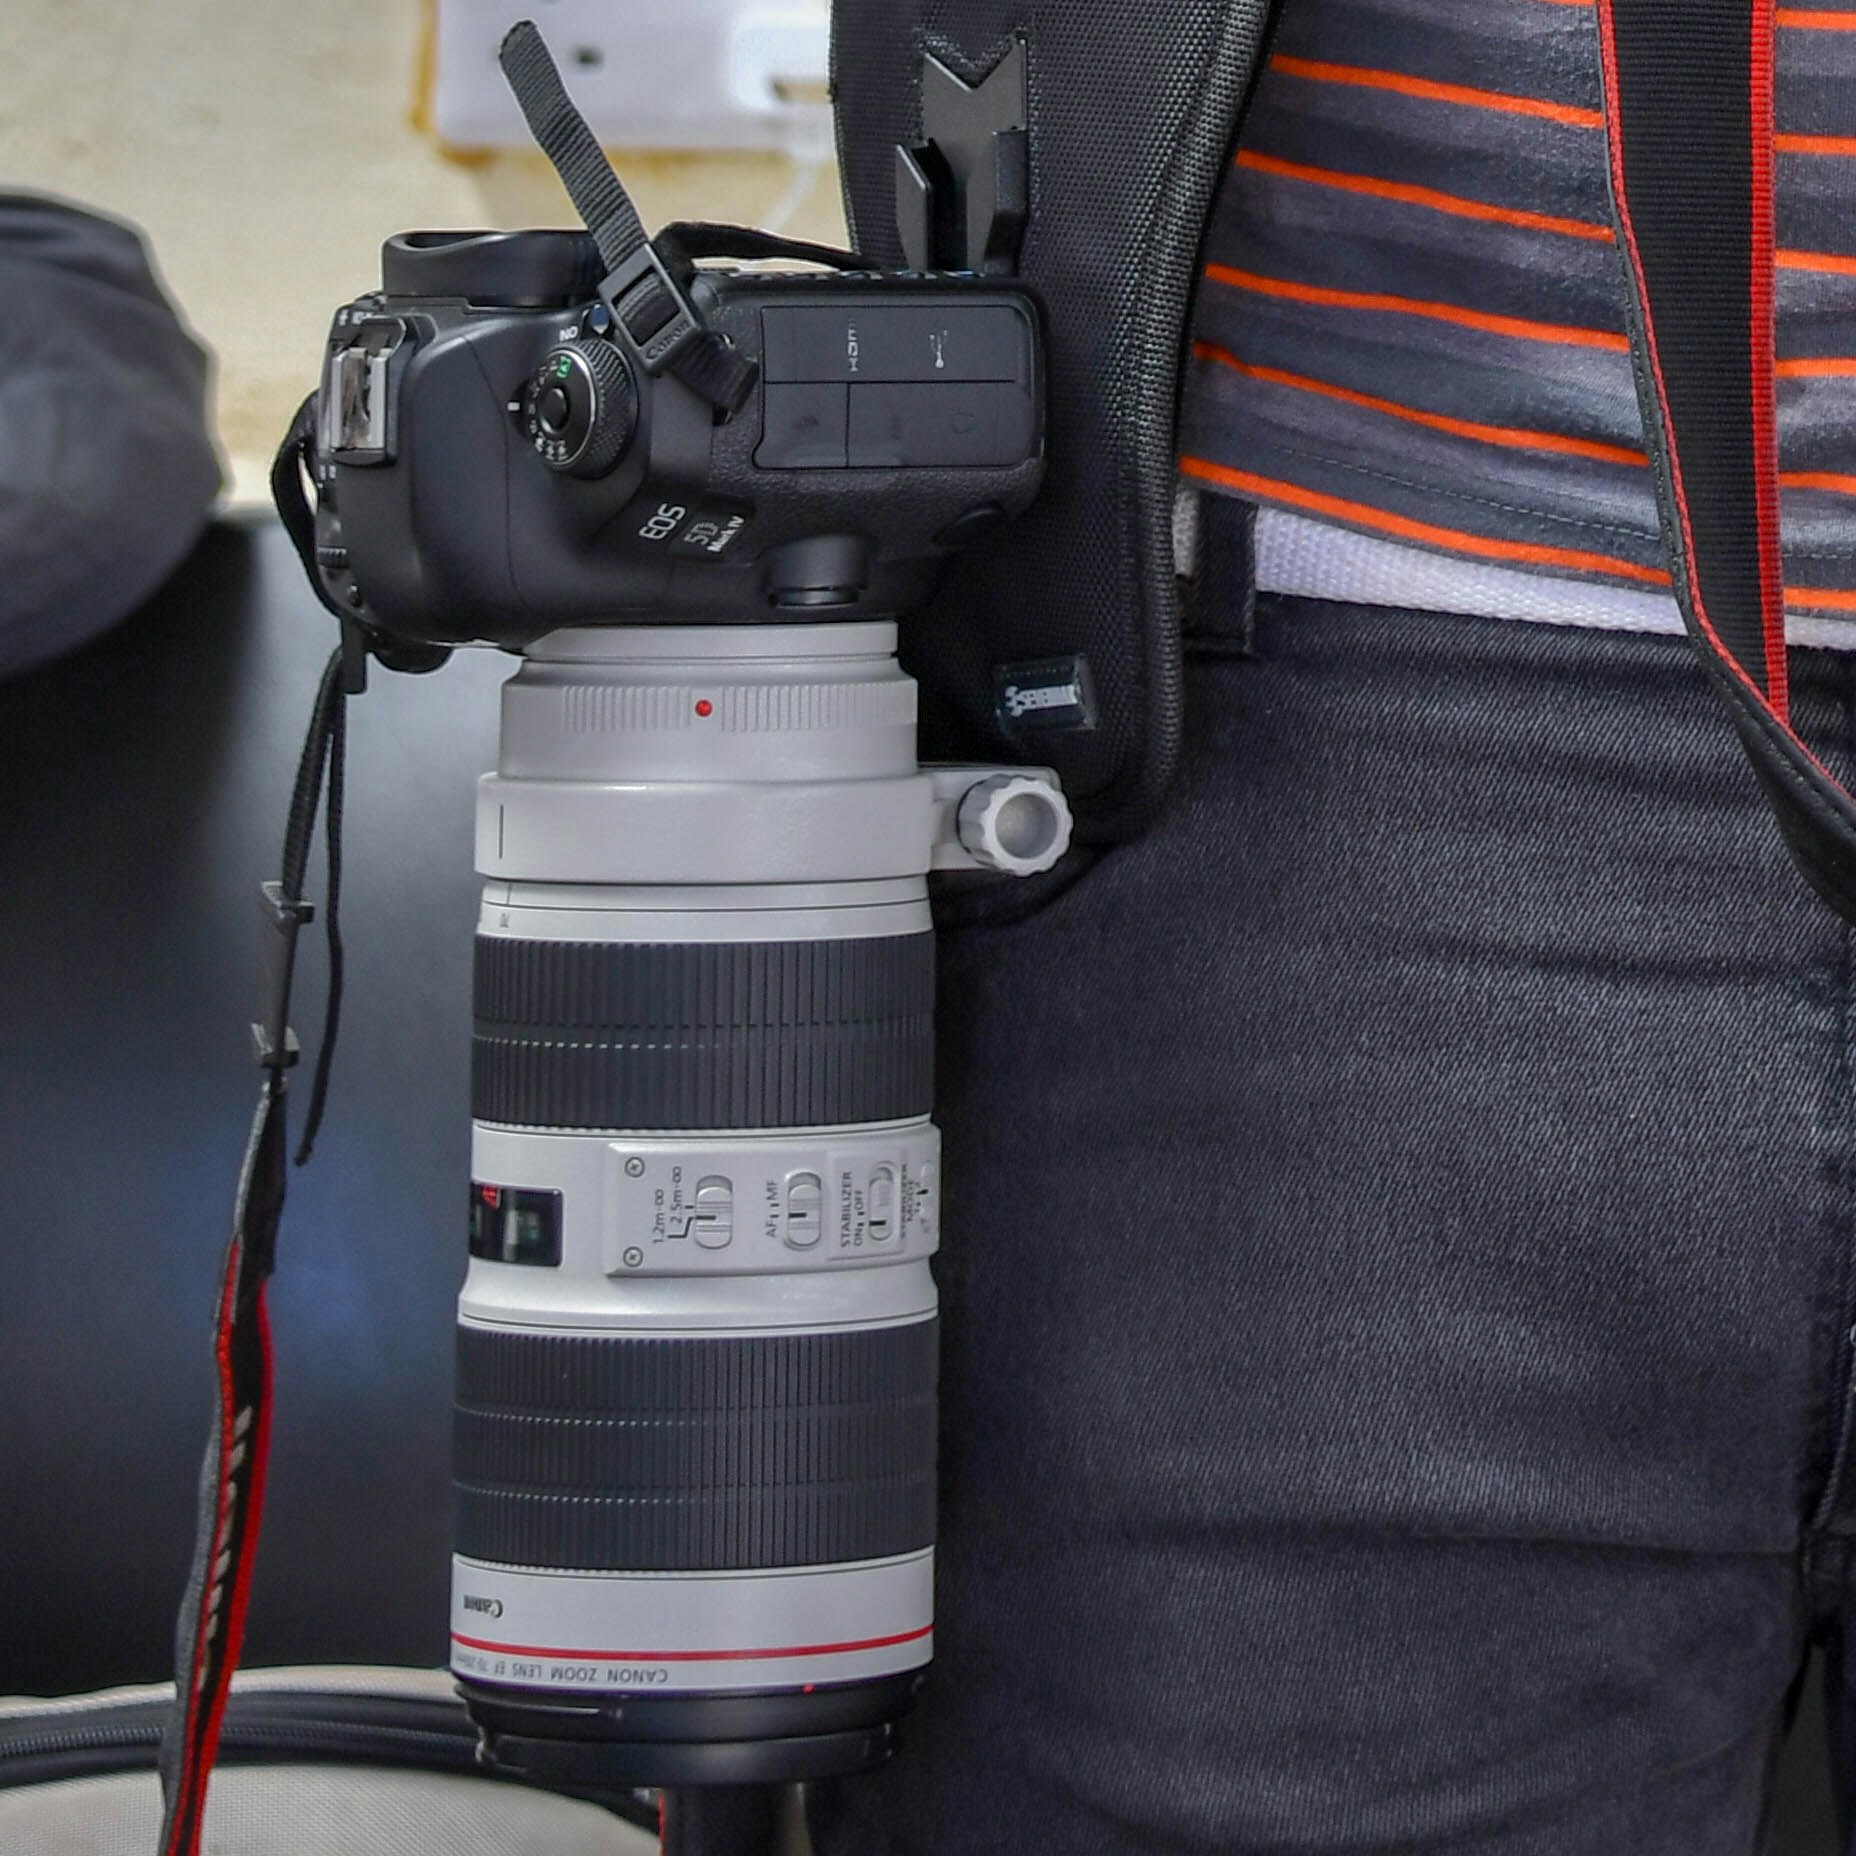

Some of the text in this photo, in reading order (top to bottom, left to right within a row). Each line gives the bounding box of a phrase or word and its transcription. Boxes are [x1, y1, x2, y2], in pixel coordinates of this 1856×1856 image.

[639, 502, 686, 540] EOS
[684, 521, 720, 546] 5D
[766, 1181, 779, 1205] MF
[840, 1170, 852, 1248] STABILIZER
[765, 1222, 778, 1238] AF
[550, 1666, 598, 1681] ZOOM
[606, 1668, 669, 1683] CANON
